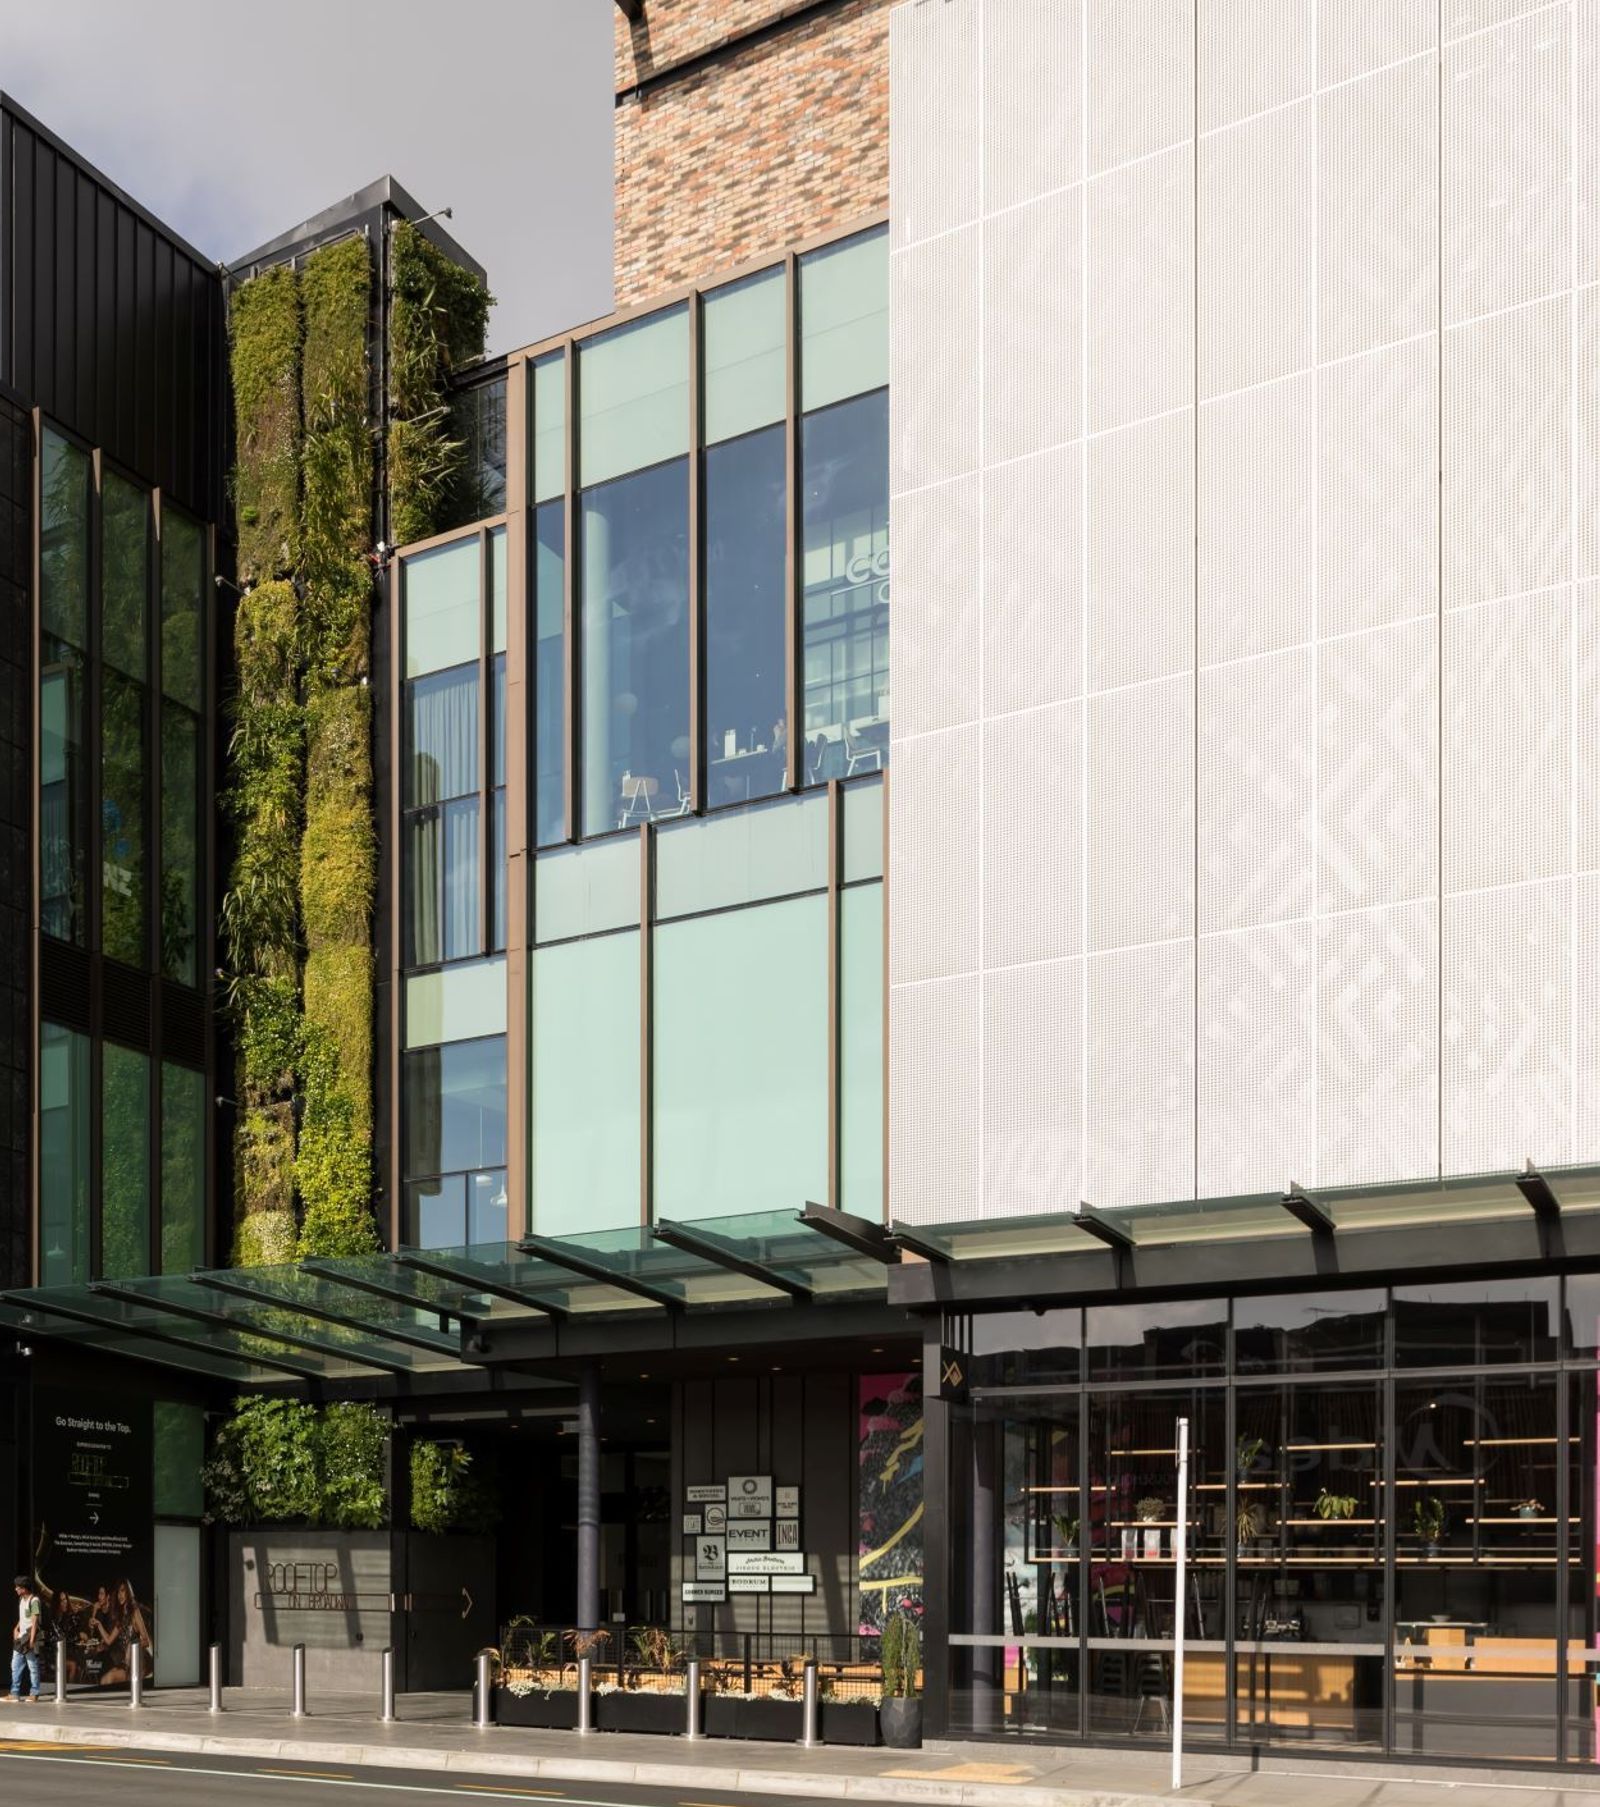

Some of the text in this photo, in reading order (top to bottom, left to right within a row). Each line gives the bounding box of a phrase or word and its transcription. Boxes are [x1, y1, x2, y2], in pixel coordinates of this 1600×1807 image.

[55, 1416, 66, 1426] Go
[67, 1417, 94, 1431] Straight
[96, 1420, 103, 1430] to
[104, 1421, 116, 1431] the
[729, 1529, 768, 1538] EVENT
